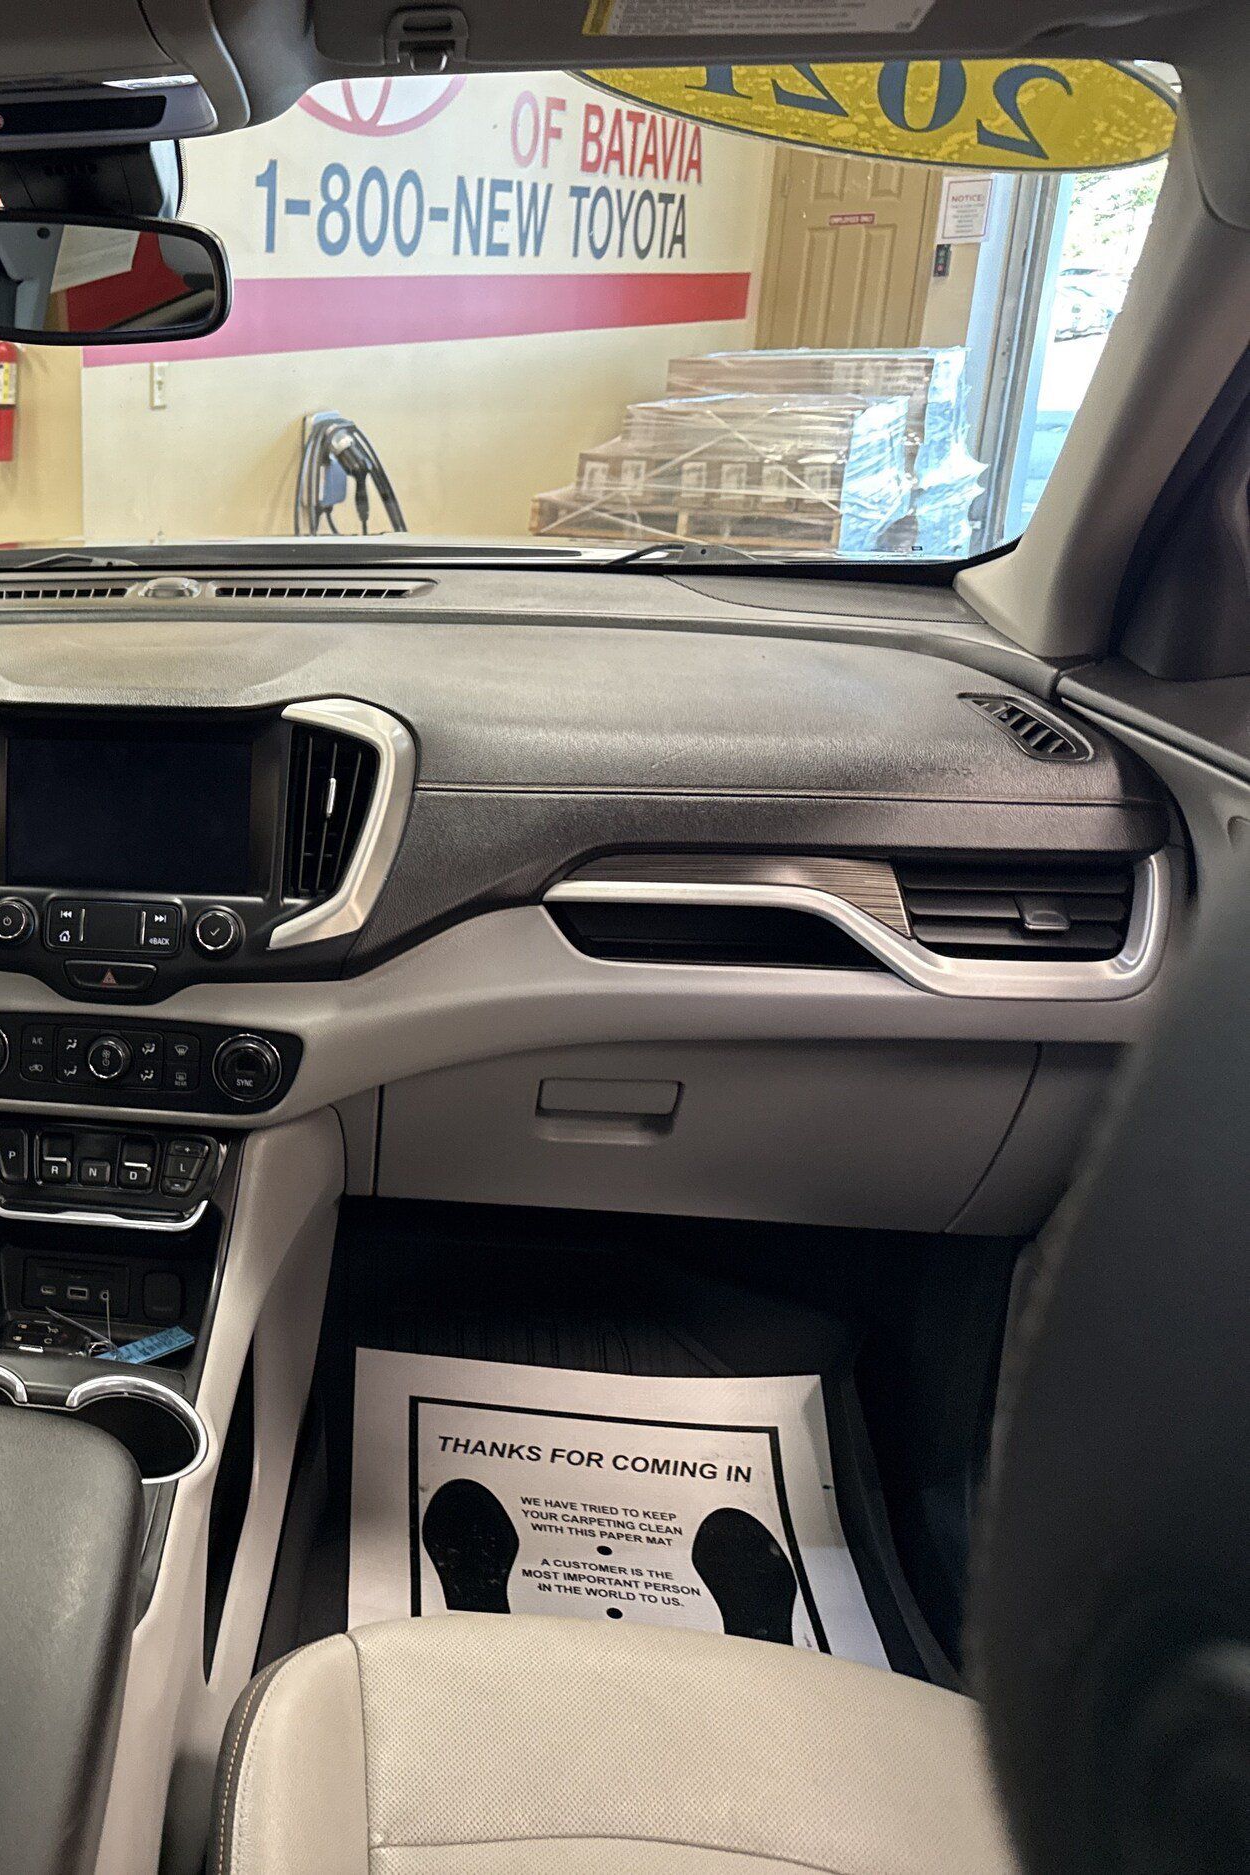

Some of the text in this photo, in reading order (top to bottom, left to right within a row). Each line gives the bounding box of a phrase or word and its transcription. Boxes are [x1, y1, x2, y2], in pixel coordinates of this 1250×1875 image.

[511, 89, 704, 185] OF BATAVIA
[255, 158, 687, 261] 1-800-NEW TOYOTA
[153, 937, 170, 945] BACK
[32, 1037, 43, 1045] A/C
[236, 1079, 254, 1087] SYNC
[8, 1151, 16, 1160] P
[51, 1165, 59, 1175] R
[88, 1167, 97, 1177] N
[129, 1171, 138, 1181] D
[180, 1163, 186, 1172] L
[438, 1435, 753, 1484] THANKS FOR COMING IN
[520, 1496, 677, 1522] WE HAVE TRIED TO KEEP
[521, 1509, 683, 1536] YOUR CARPETING CLEAN
[530, 1522, 673, 1547] WITH THIS PAPER MAT
[541, 1558, 674, 1580] A CUSTOMER IS THE
[521, 1569, 701, 1597] MOST IMPORTANT PERSON
[538, 1582, 685, 1607] IN THE WORLD TO US.
